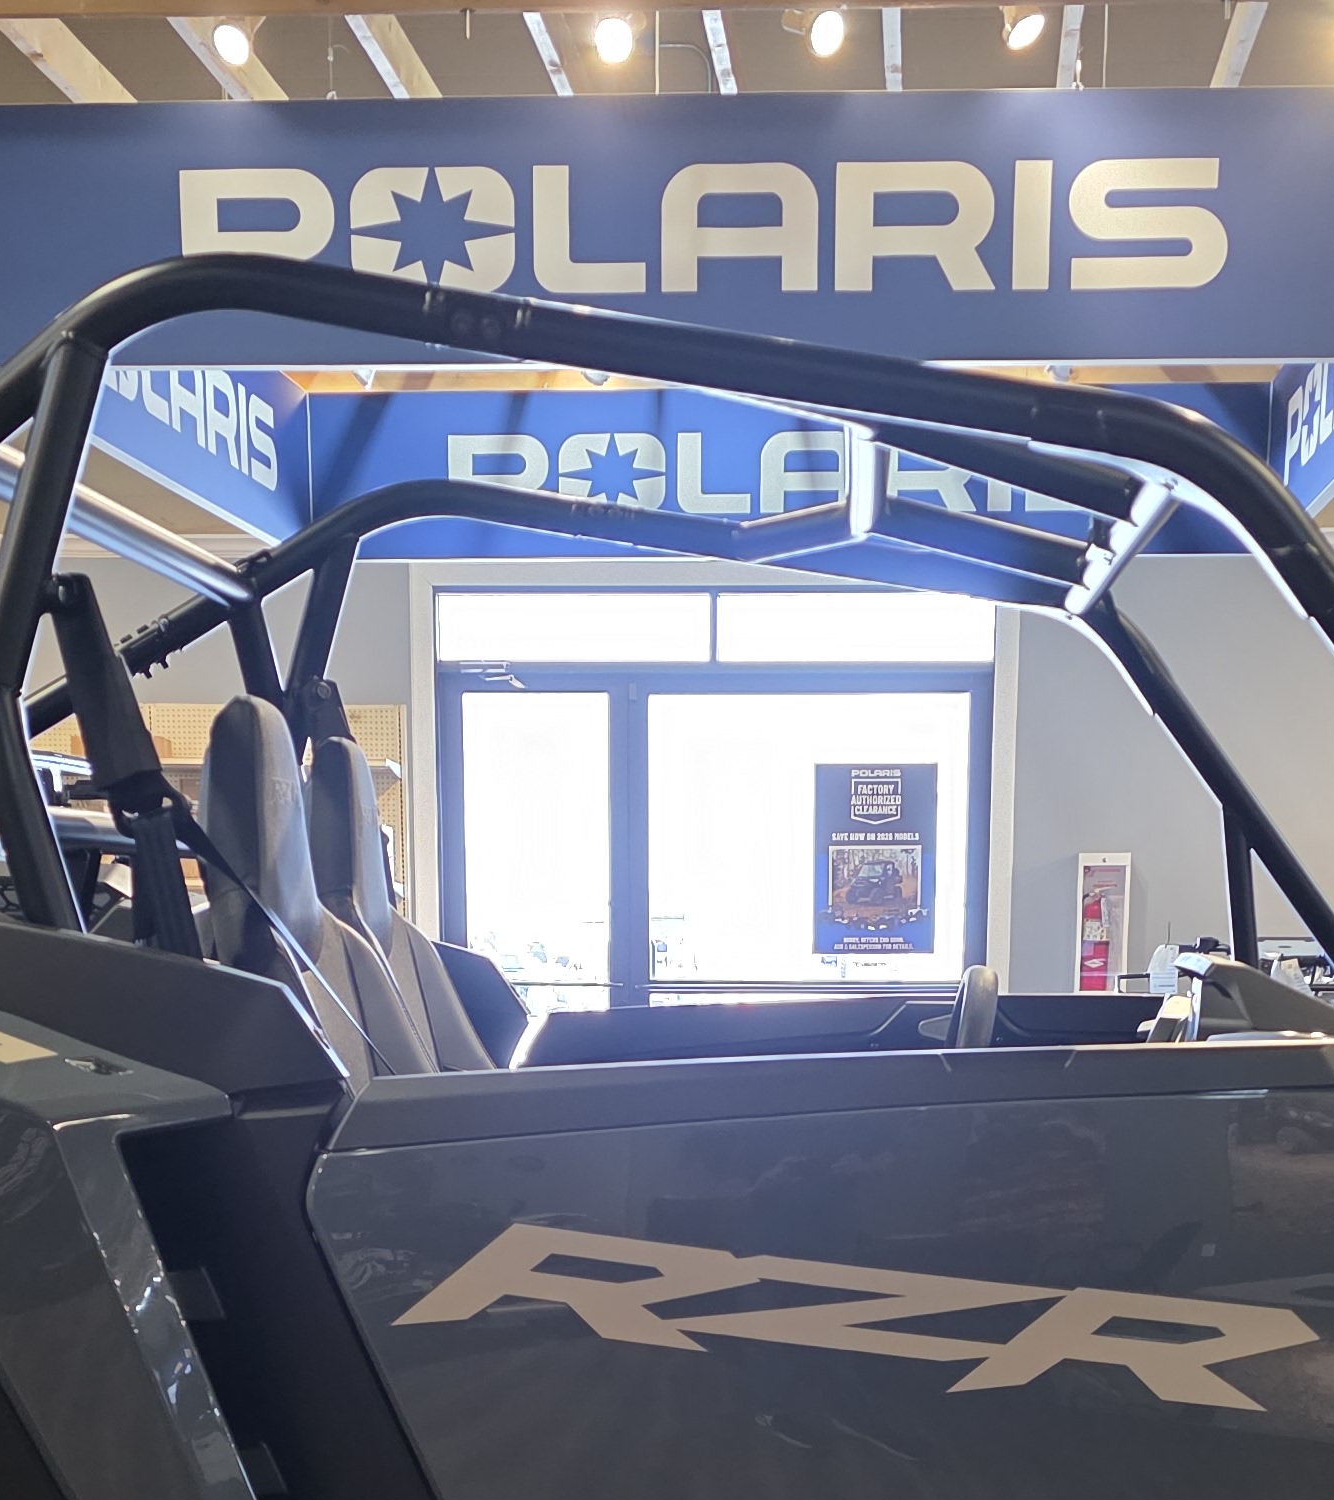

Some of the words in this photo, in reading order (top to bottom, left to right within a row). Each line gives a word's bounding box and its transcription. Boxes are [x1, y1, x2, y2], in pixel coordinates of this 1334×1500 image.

[179, 157, 1229, 294] POLARIS
[105, 370, 277, 491] LARIS
[851, 769, 901, 777] POLARIS
[858, 785, 894, 794] FACTORY
[851, 795, 901, 805] AUTHORIZED
[855, 806, 897, 814] CLEARANCE
[832, 833, 848, 841] SAVE
[390, 1223, 1321, 1412] RZR
